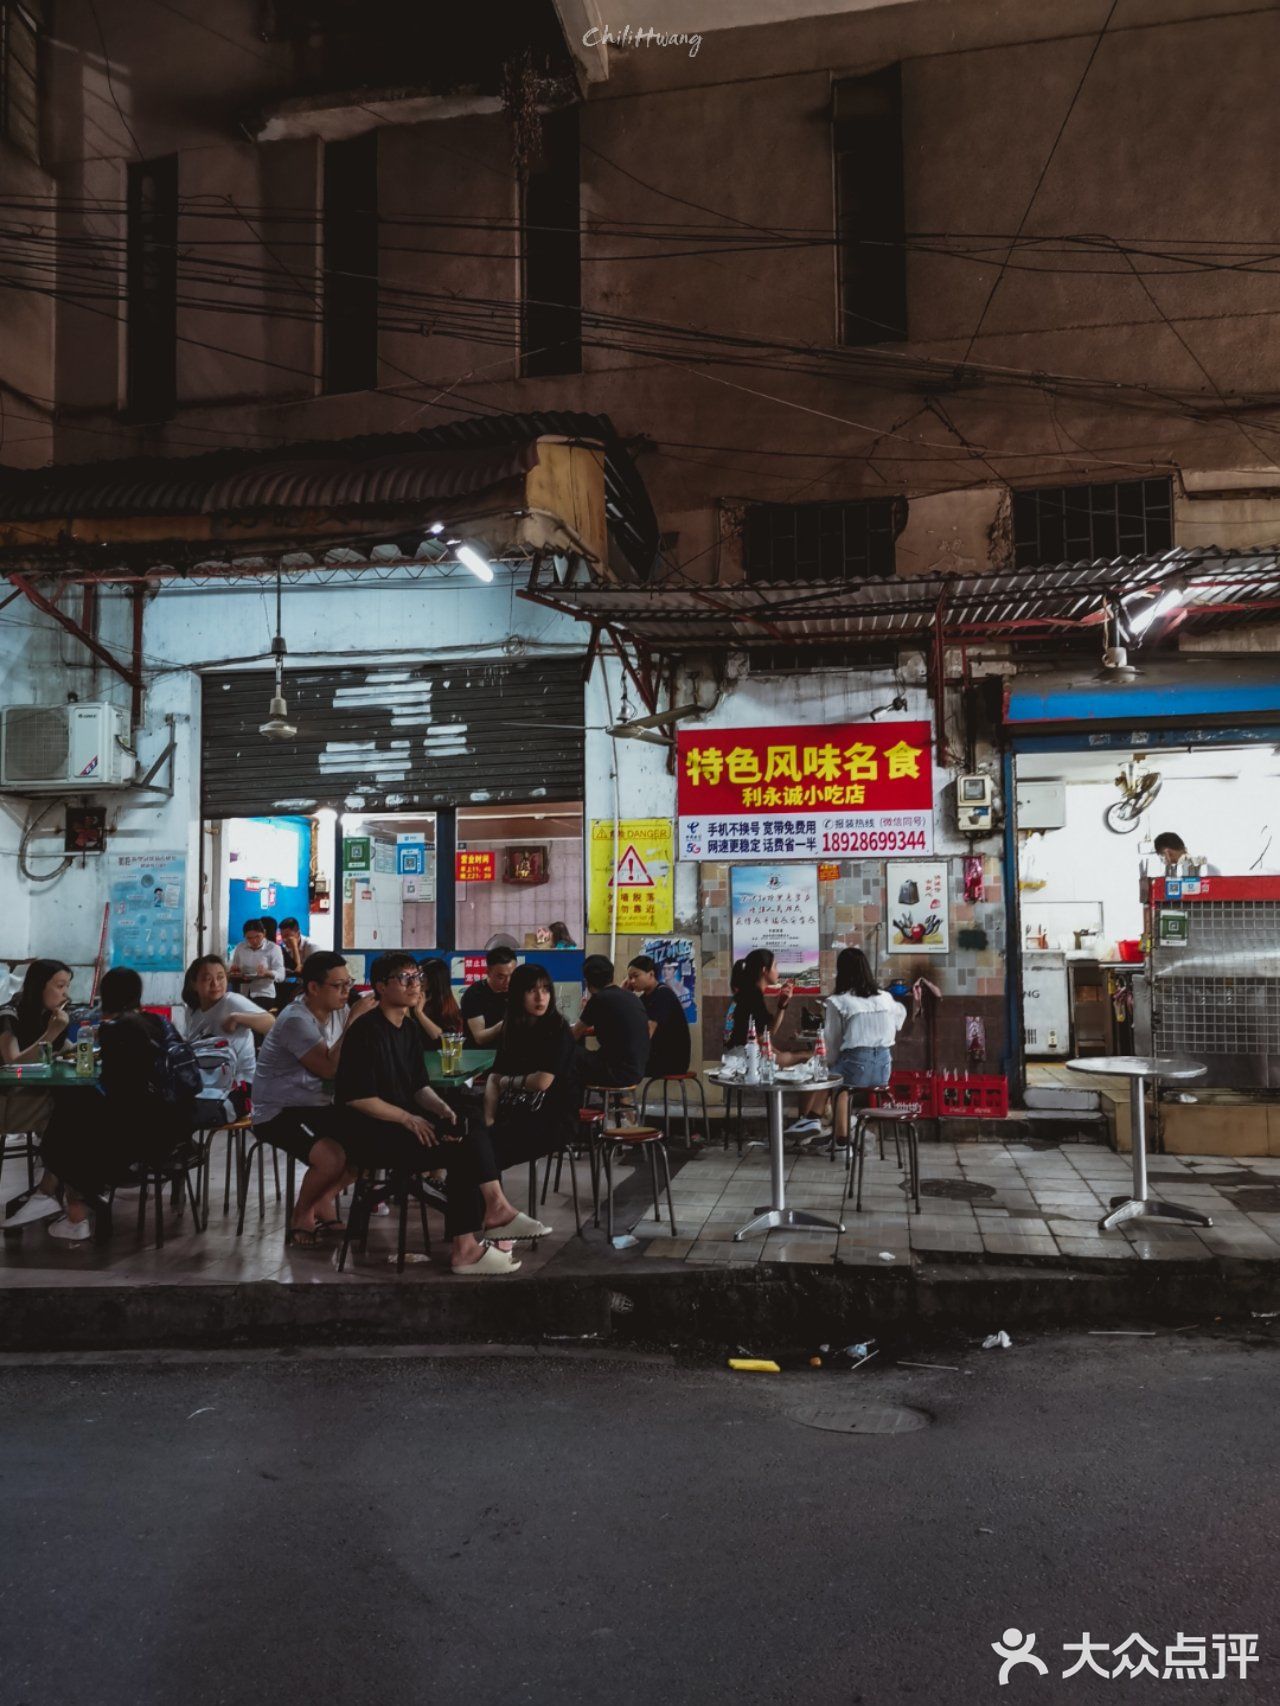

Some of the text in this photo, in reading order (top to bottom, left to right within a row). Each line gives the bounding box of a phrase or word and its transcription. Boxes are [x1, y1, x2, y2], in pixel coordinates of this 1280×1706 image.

[686, 741, 923, 786] 特色风味名食
[742, 785, 866, 808] 利永诚小吃店
[707, 819, 817, 837] 手机不换号 宽带免费用
[835, 818, 875, 829] 报装热线
[627, 829, 667, 839] DANGER
[822, 830, 926, 852] 18928699344
[686, 842, 702, 854] 5G
[707, 837, 817, 854] 网速更稳定 话费省一半
